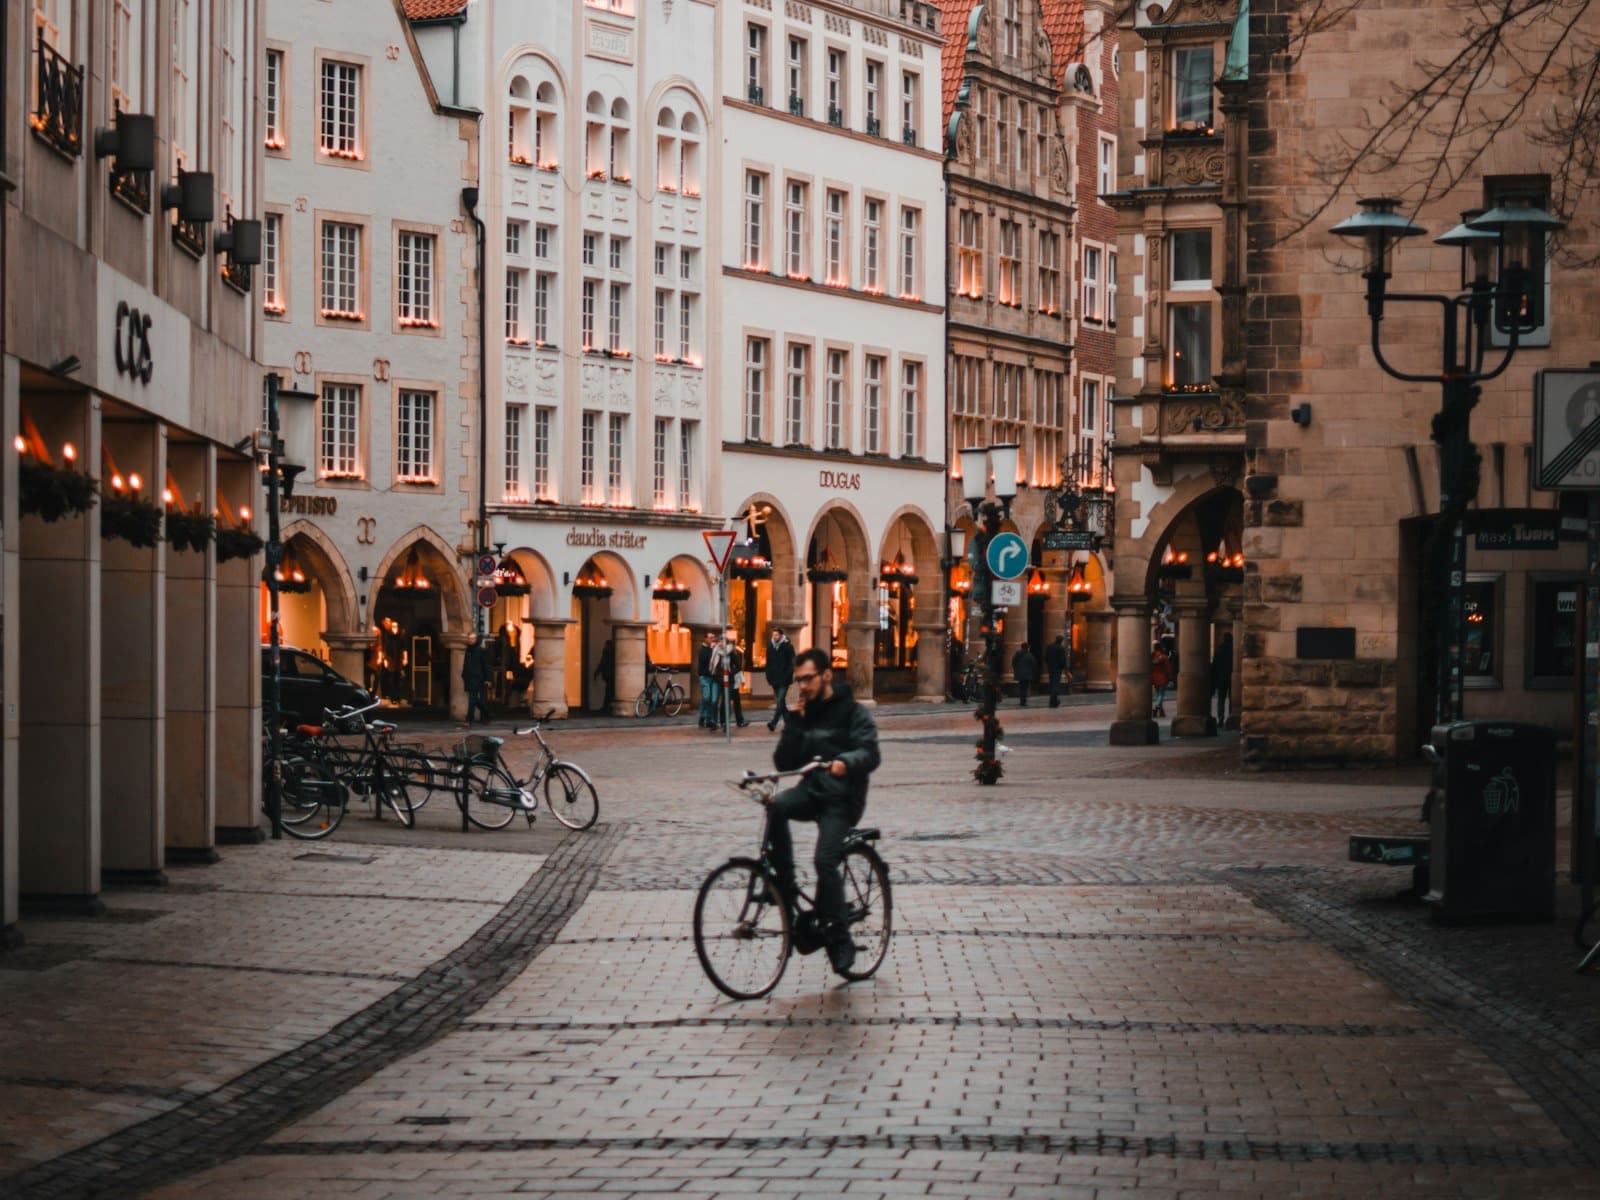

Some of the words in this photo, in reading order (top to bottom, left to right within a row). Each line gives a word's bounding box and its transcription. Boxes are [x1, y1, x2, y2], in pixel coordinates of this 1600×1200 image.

[819, 470, 861, 491] DOUGLAS
[566, 525, 606, 547] claudia
[608, 529, 647, 550] sträter
